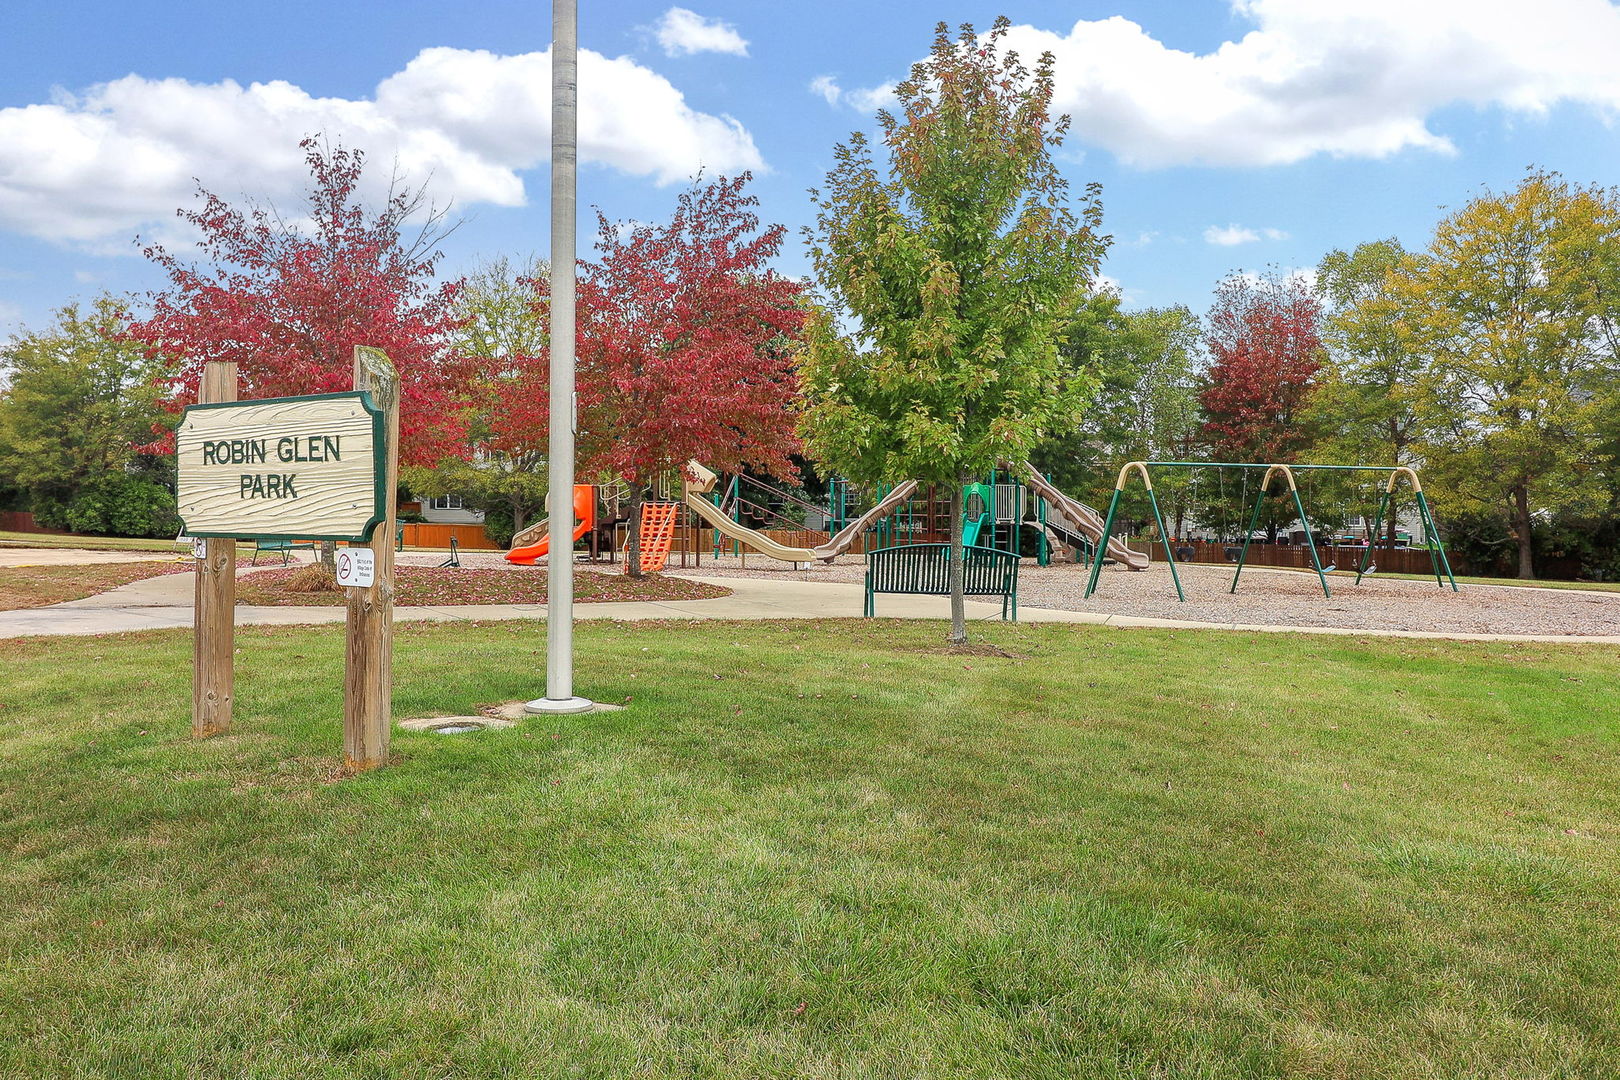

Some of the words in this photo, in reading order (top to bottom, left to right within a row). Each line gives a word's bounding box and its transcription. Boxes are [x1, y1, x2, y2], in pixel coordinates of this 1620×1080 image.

[203, 439, 265, 465] ROBIN
[277, 435, 340, 462] GLEN
[240, 473, 298, 499] PARK
